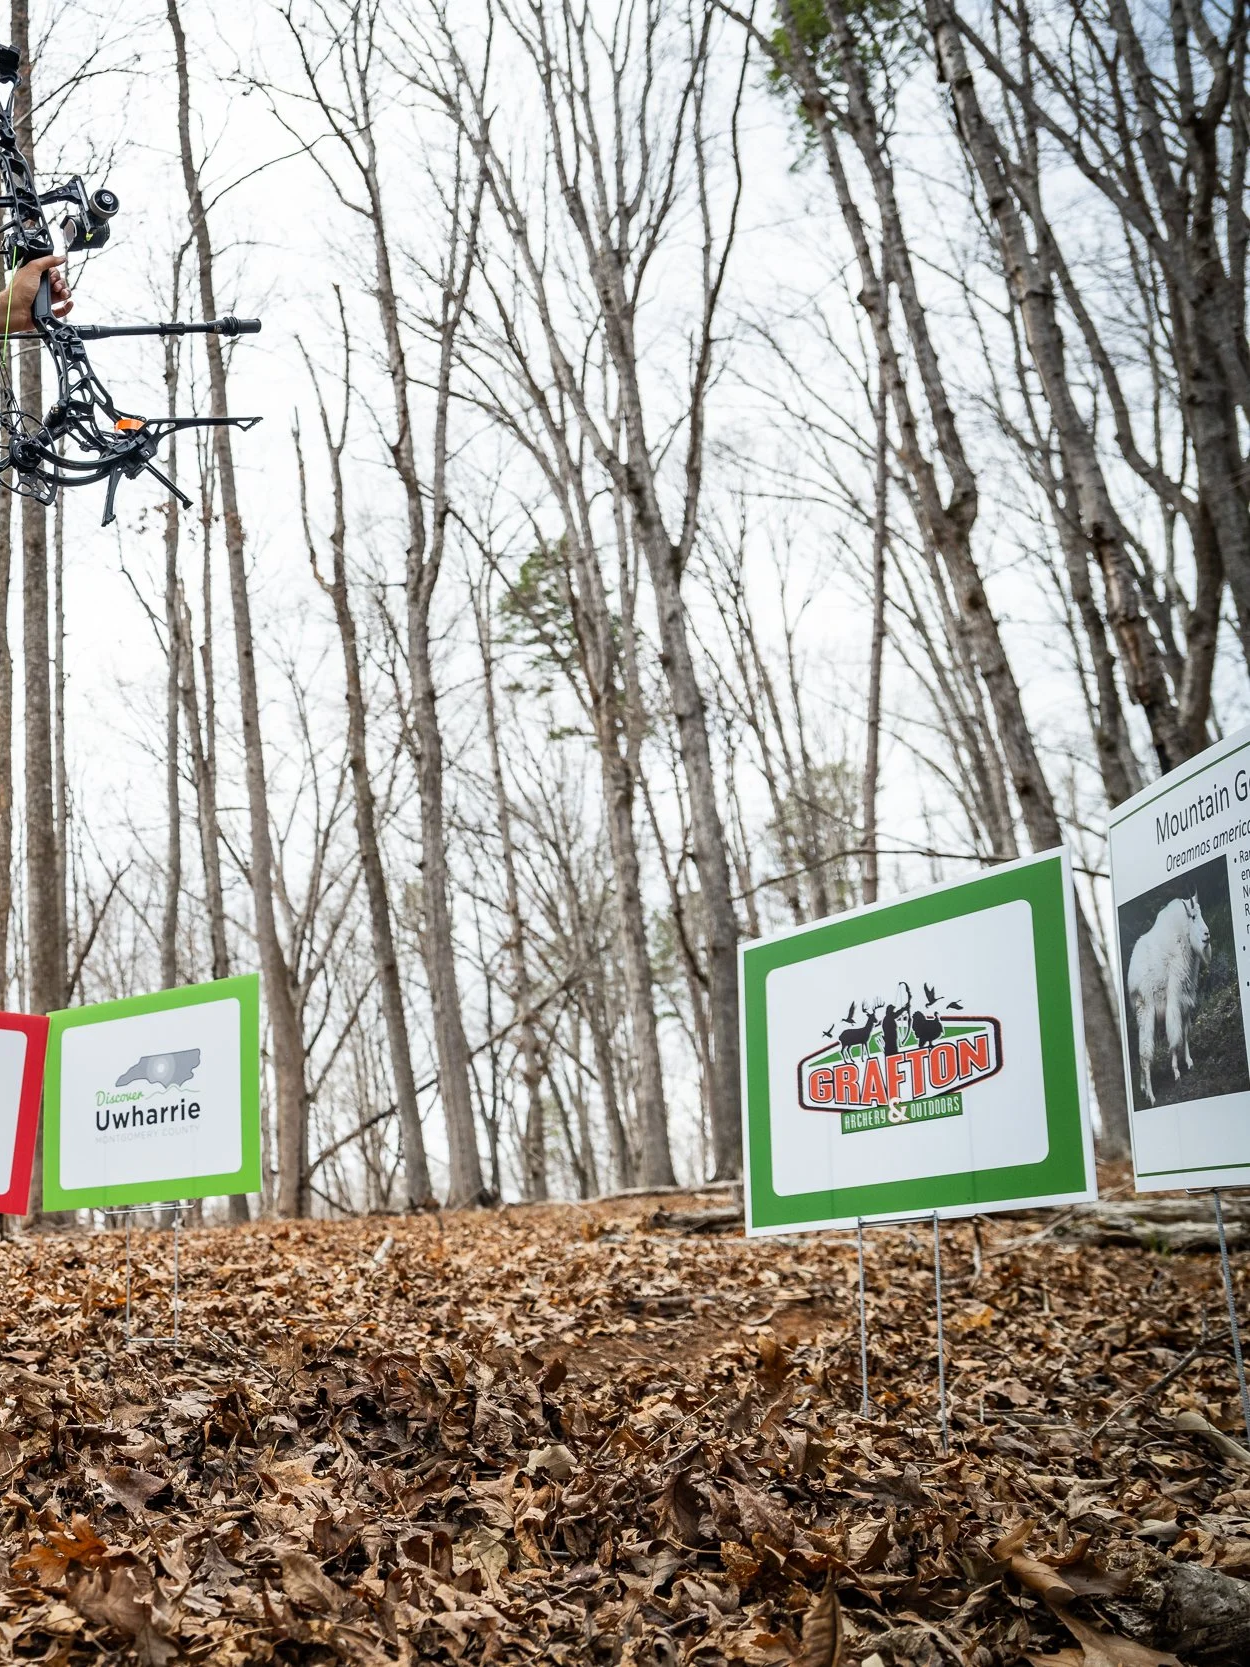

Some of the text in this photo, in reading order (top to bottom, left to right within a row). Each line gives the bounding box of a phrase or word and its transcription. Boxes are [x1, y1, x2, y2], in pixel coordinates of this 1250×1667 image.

[1156, 769, 1250, 845] Mountain G
[1166, 839, 1211, 872] Oreamnos
[808, 1034, 990, 1106] GRAFTON
[95, 1090, 144, 1107] Discover
[96, 1098, 201, 1131] Uwharrie
[844, 1096, 961, 1130] ARCHERY & OUTDOORS
[94, 1124, 200, 1145] MONTGOMERY COUNTY
